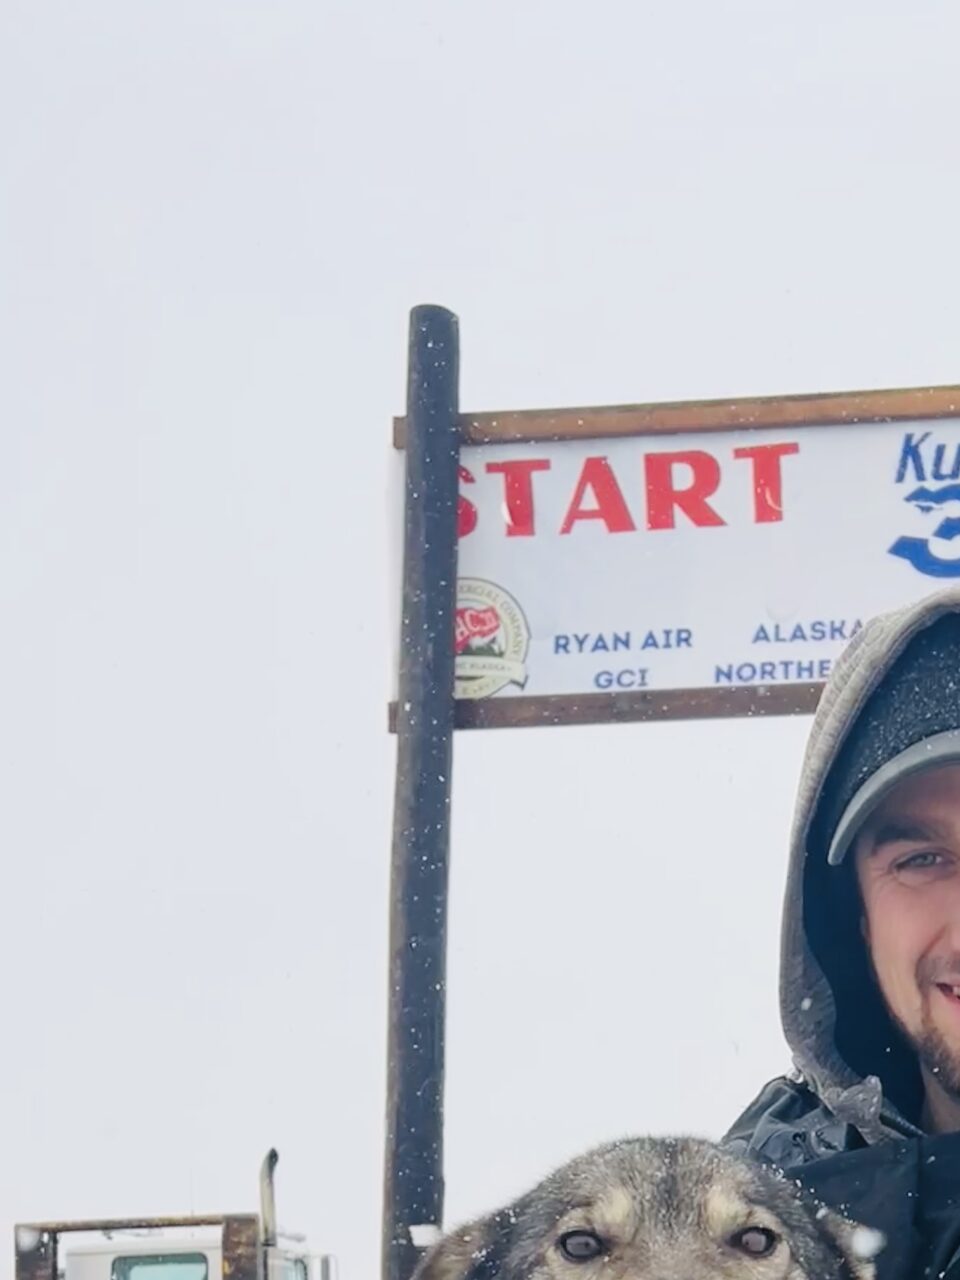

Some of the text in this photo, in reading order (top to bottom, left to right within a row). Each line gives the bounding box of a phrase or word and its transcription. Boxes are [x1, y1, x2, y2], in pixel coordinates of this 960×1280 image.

[553, 629, 693, 655] RYAN AIR
[593, 668, 648, 689] GCI
